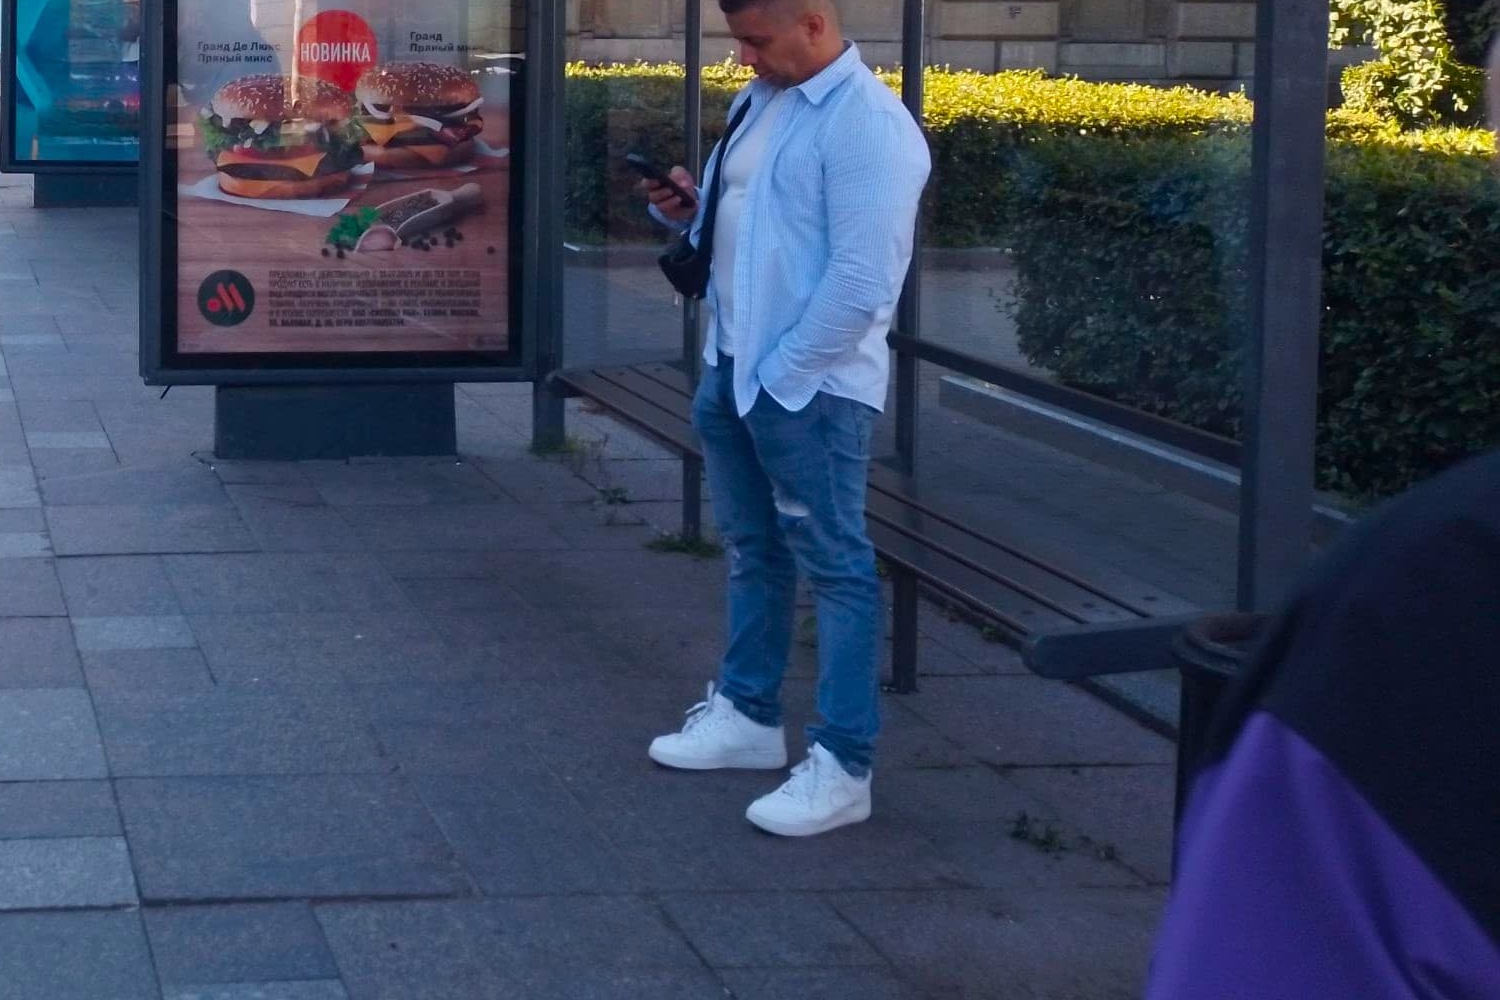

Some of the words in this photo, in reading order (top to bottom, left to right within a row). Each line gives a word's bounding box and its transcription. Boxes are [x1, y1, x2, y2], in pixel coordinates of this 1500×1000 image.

[410, 31, 443, 42] Гранд
[197, 41, 230, 52] Гранд
[233, 41, 248, 52] Де
[300, 41, 371, 63] НОВИНКА
[410, 42, 454, 52] Пряный
[198, 52, 242, 63] Пряный
[244, 55, 273, 63] микс
